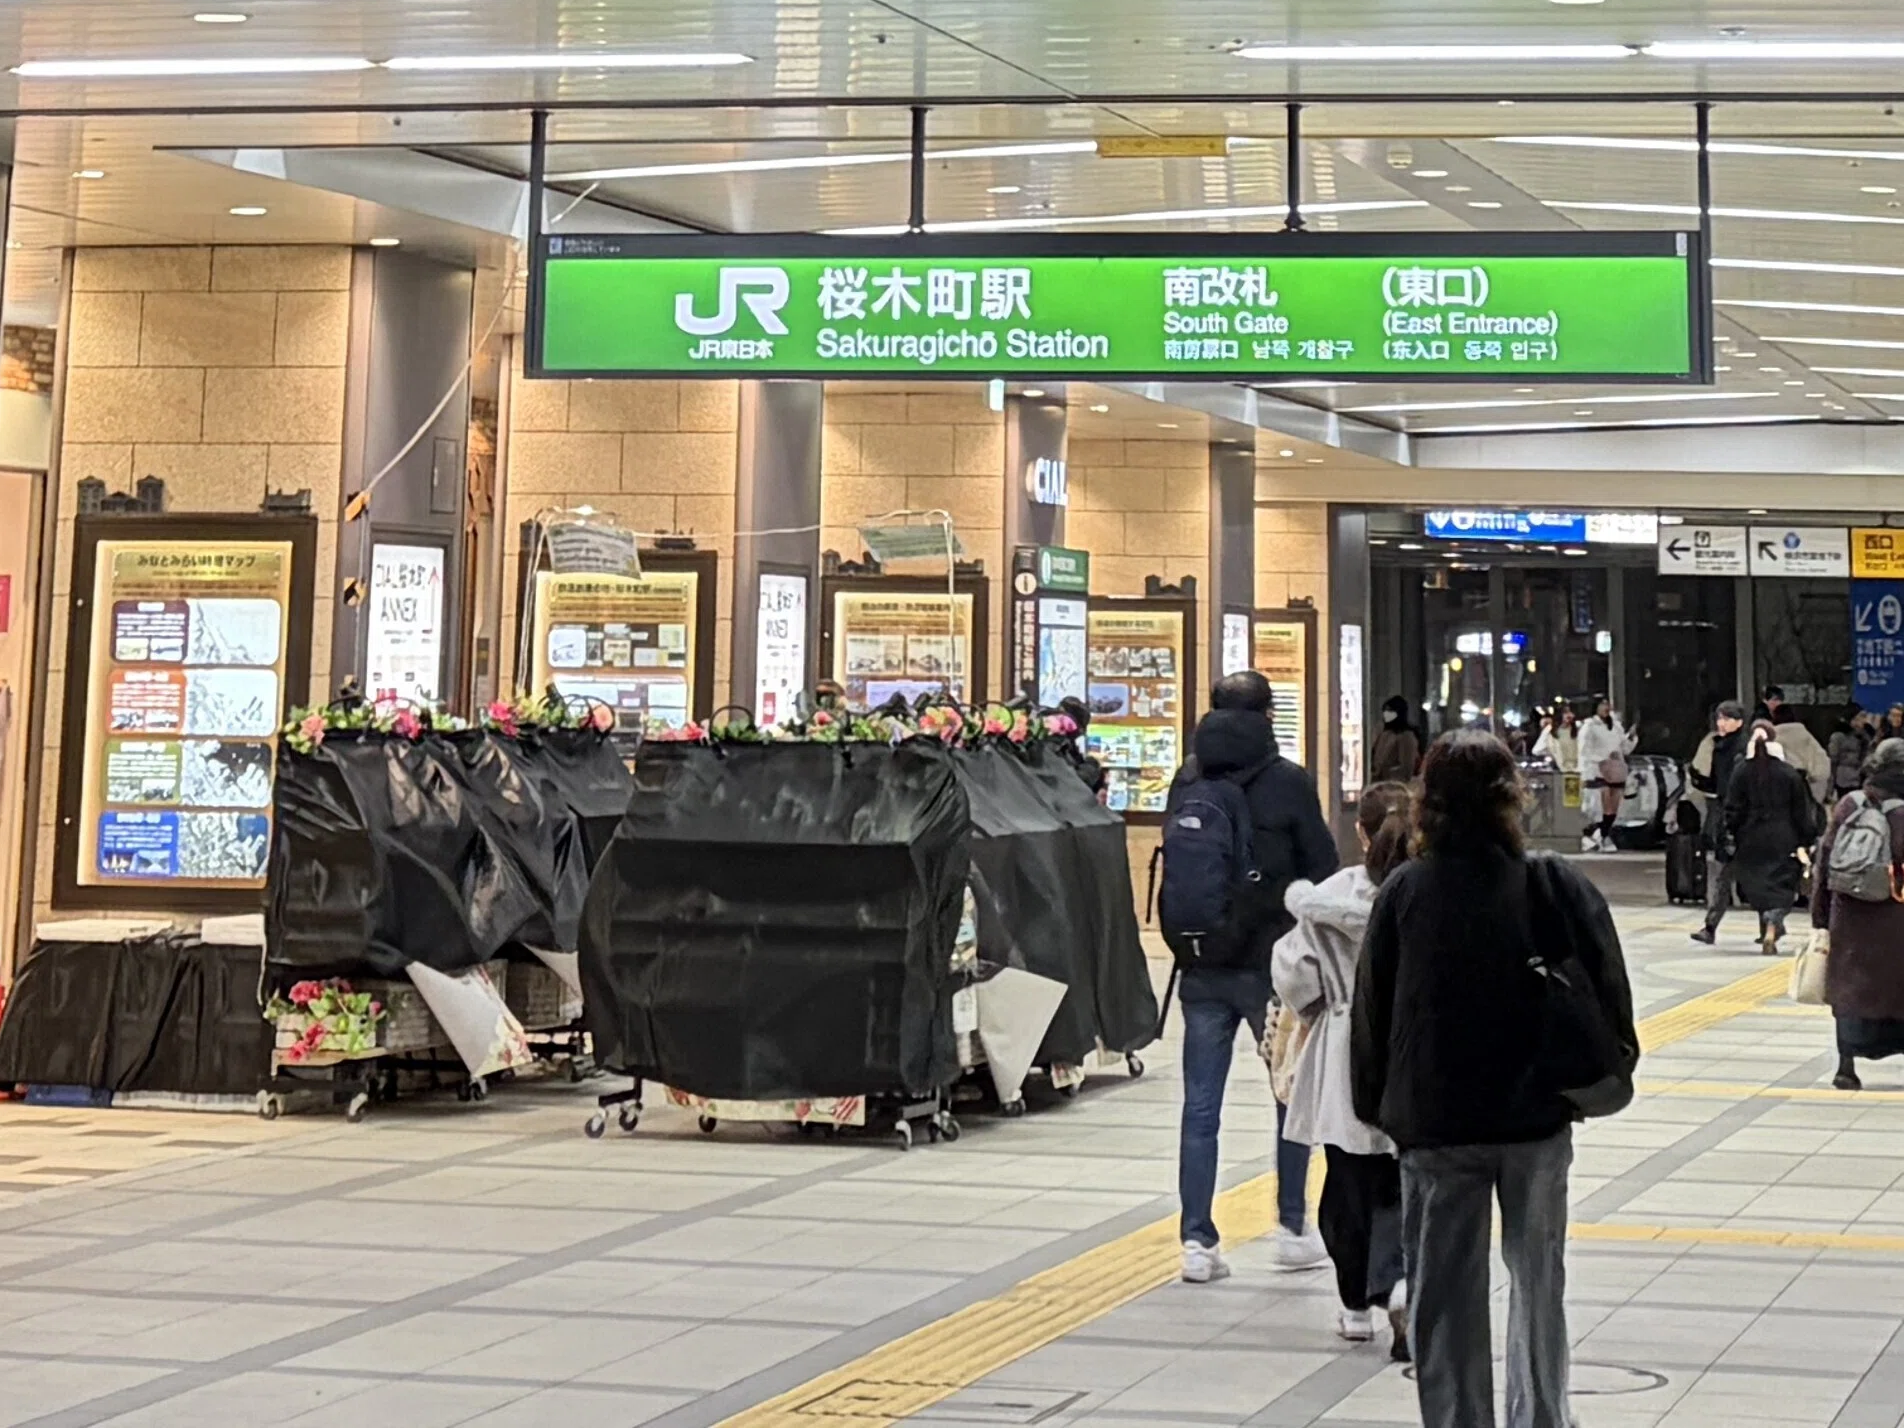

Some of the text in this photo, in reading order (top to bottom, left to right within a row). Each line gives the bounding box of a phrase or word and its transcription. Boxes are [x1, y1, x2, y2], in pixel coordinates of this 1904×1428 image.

[674, 266, 790, 335] JR
[816, 266, 1032, 320] 桜木町駅
[1162, 266, 1279, 307] 南改札
[1381, 265, 1489, 308] (東口)
[1163, 311, 1290, 334] South Gate
[1382, 309, 1558, 337] (East Entrance)
[688, 338, 775, 360] JR東日本
[816, 327, 1109, 365] Sakuragichō Station
